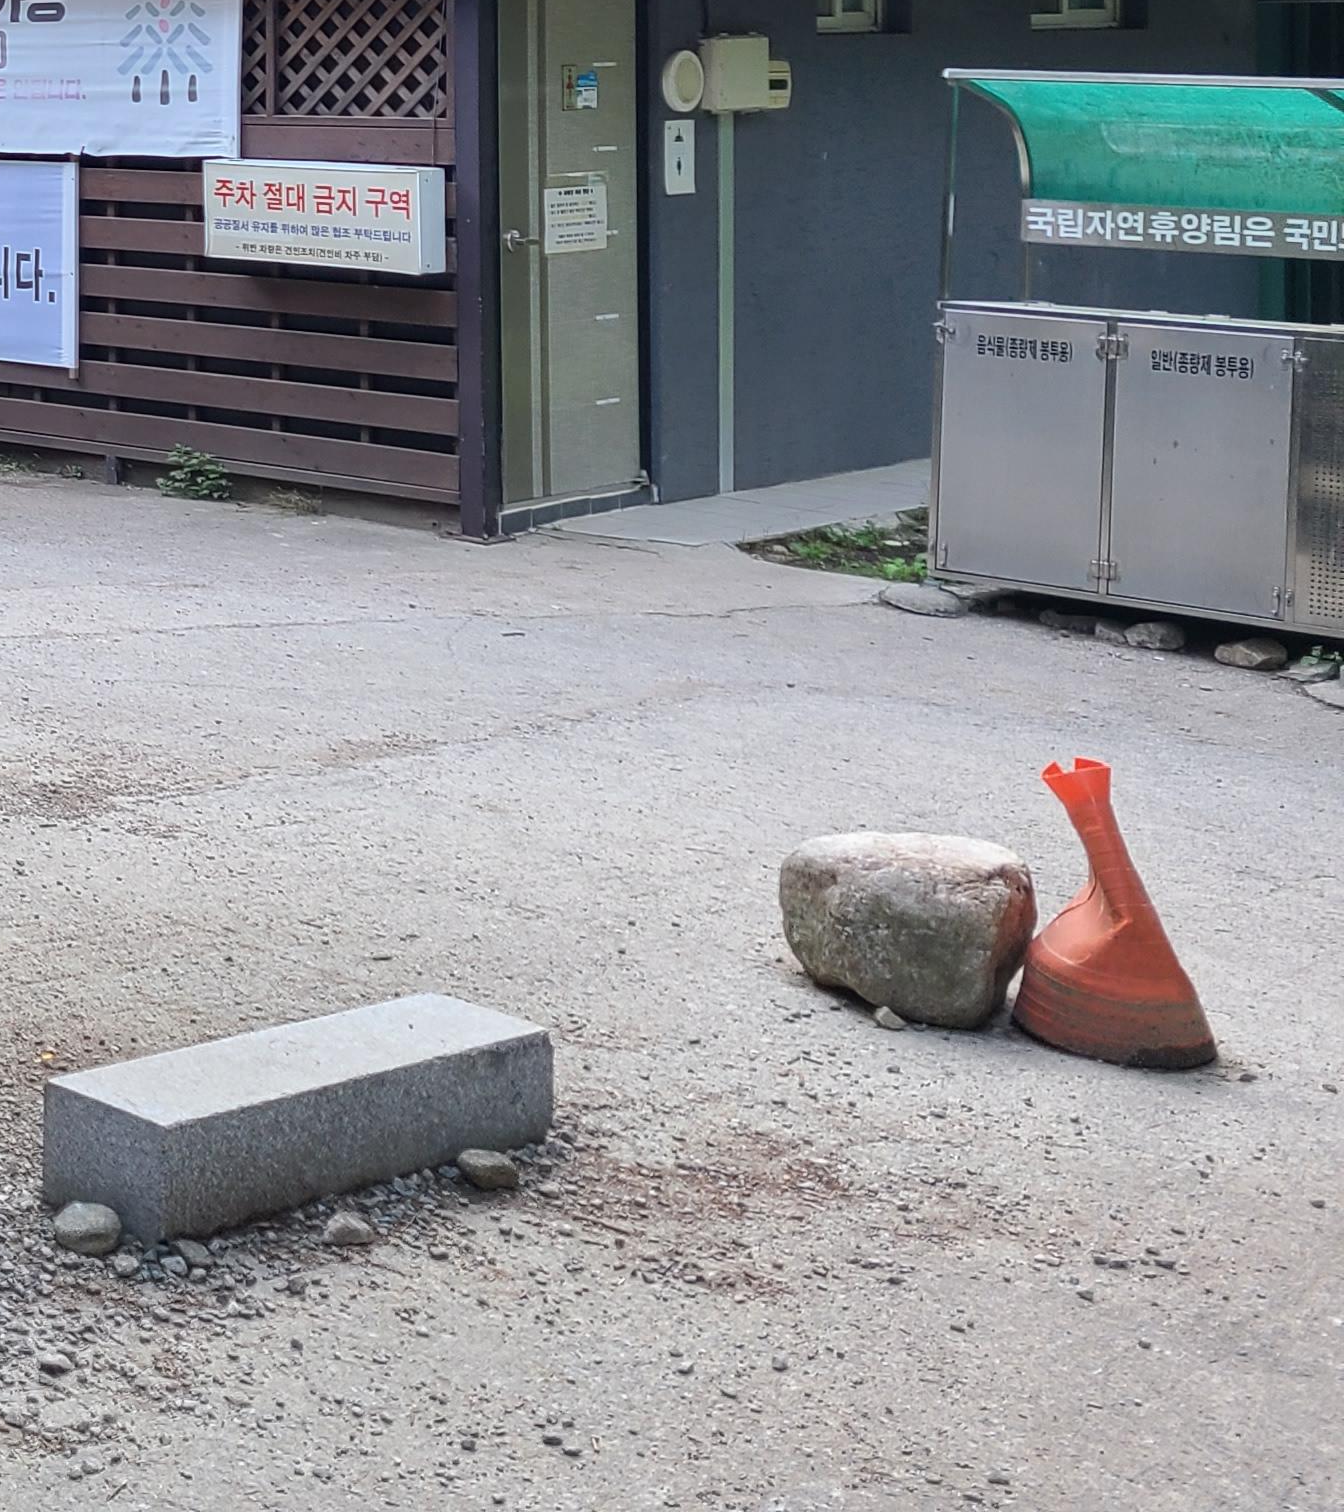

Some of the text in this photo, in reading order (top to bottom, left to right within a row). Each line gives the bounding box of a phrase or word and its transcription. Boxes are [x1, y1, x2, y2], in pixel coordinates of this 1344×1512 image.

[214, 179, 411, 220] 주차 절대 금지 구역
[251, 220, 278, 234] 유지를
[353, 228, 411, 244] 부탁드립니다
[1025, 206, 1344, 252] 국립자연휴양림은 국민
